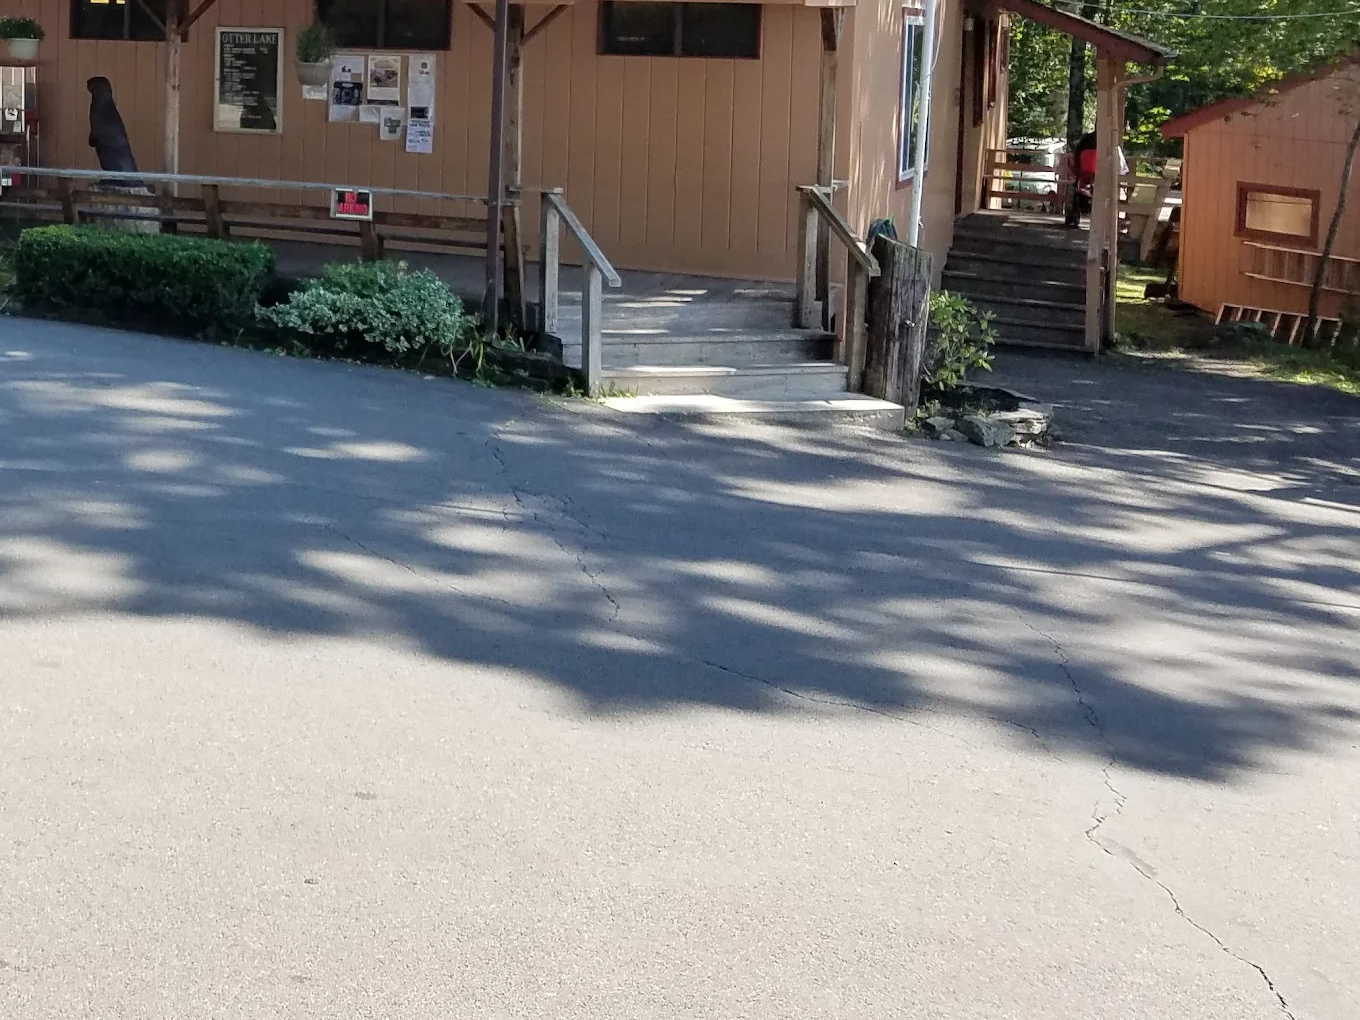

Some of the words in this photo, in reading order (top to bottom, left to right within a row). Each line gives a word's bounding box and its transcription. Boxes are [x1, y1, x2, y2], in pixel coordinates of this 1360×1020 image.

[222, 32, 251, 44] OTTER
[253, 33, 277, 45] LAKE
[345, 191, 358, 203] NO
